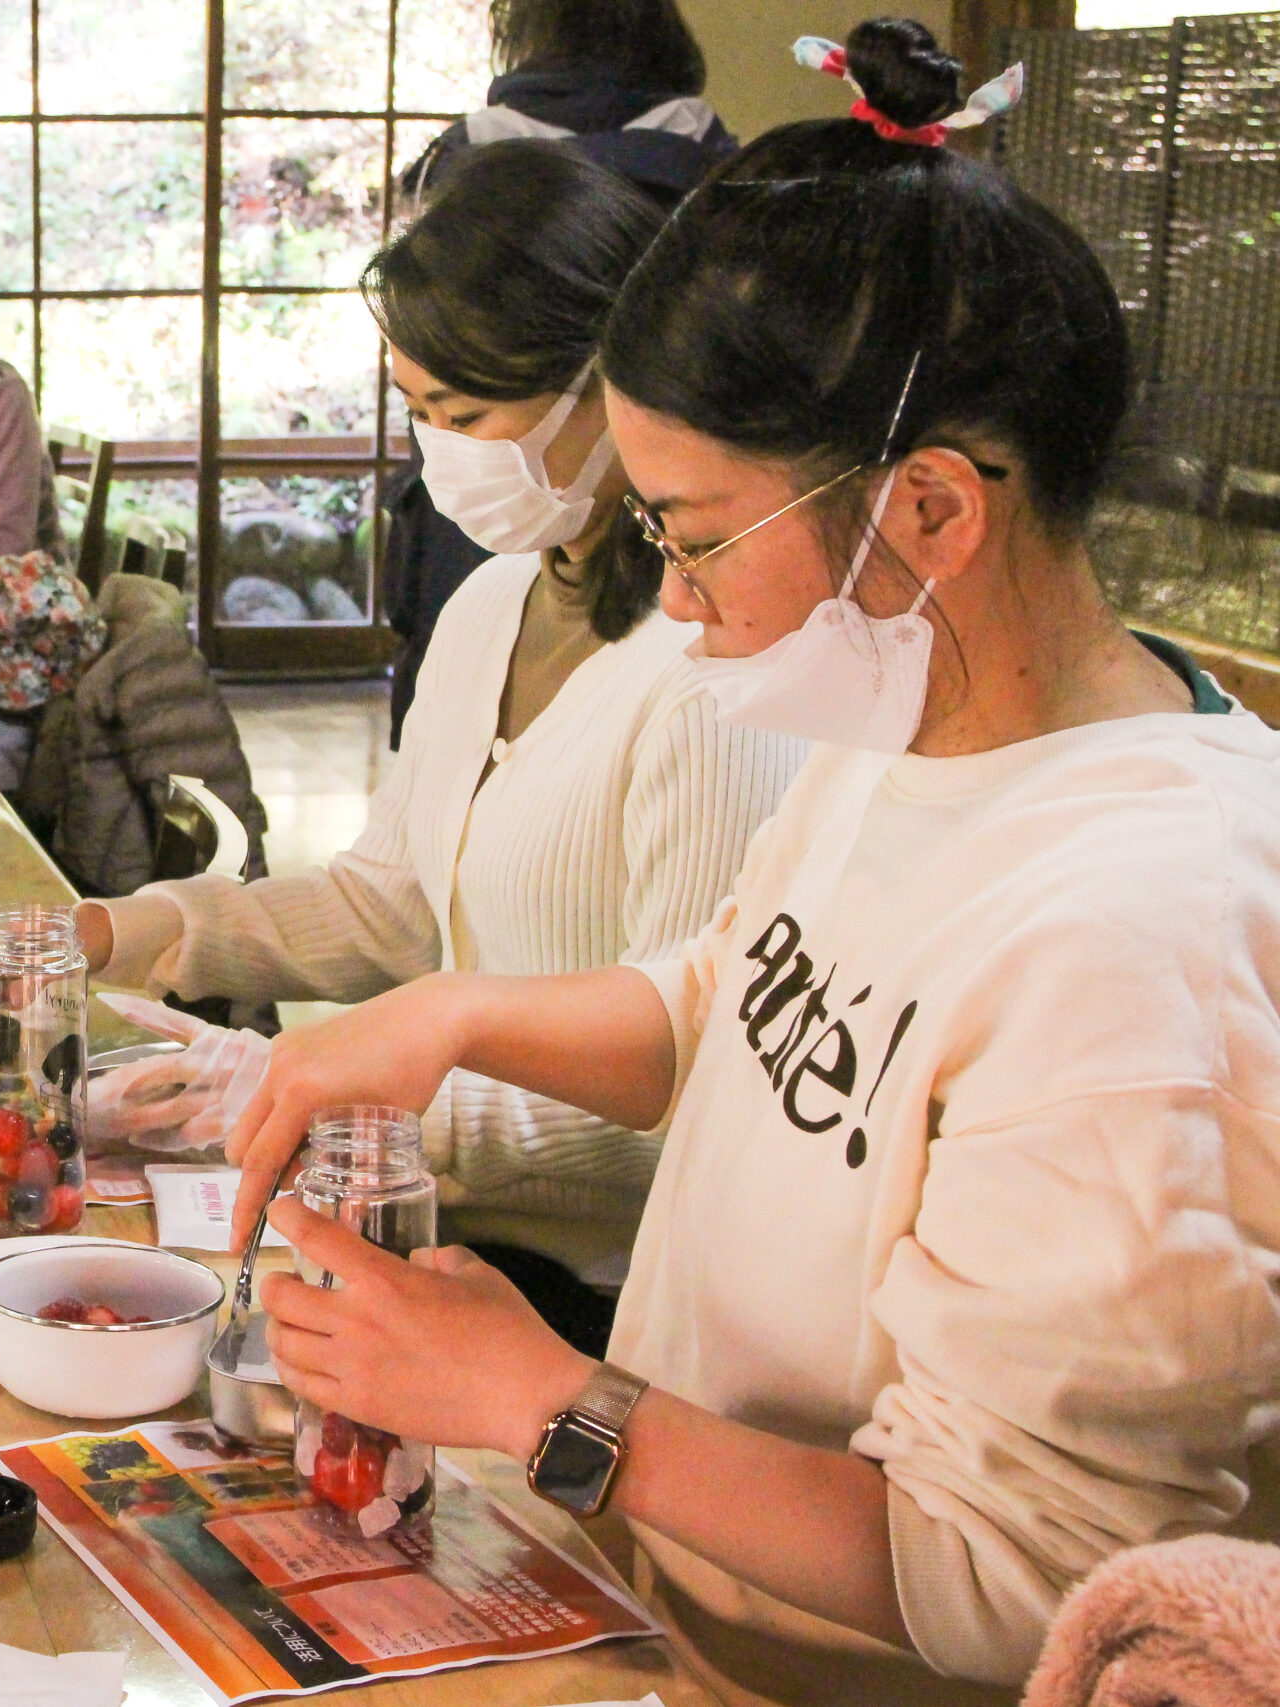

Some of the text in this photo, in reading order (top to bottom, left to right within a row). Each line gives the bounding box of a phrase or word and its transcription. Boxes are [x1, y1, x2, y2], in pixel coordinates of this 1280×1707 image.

[253, 1607, 324, 1662] 活用について
